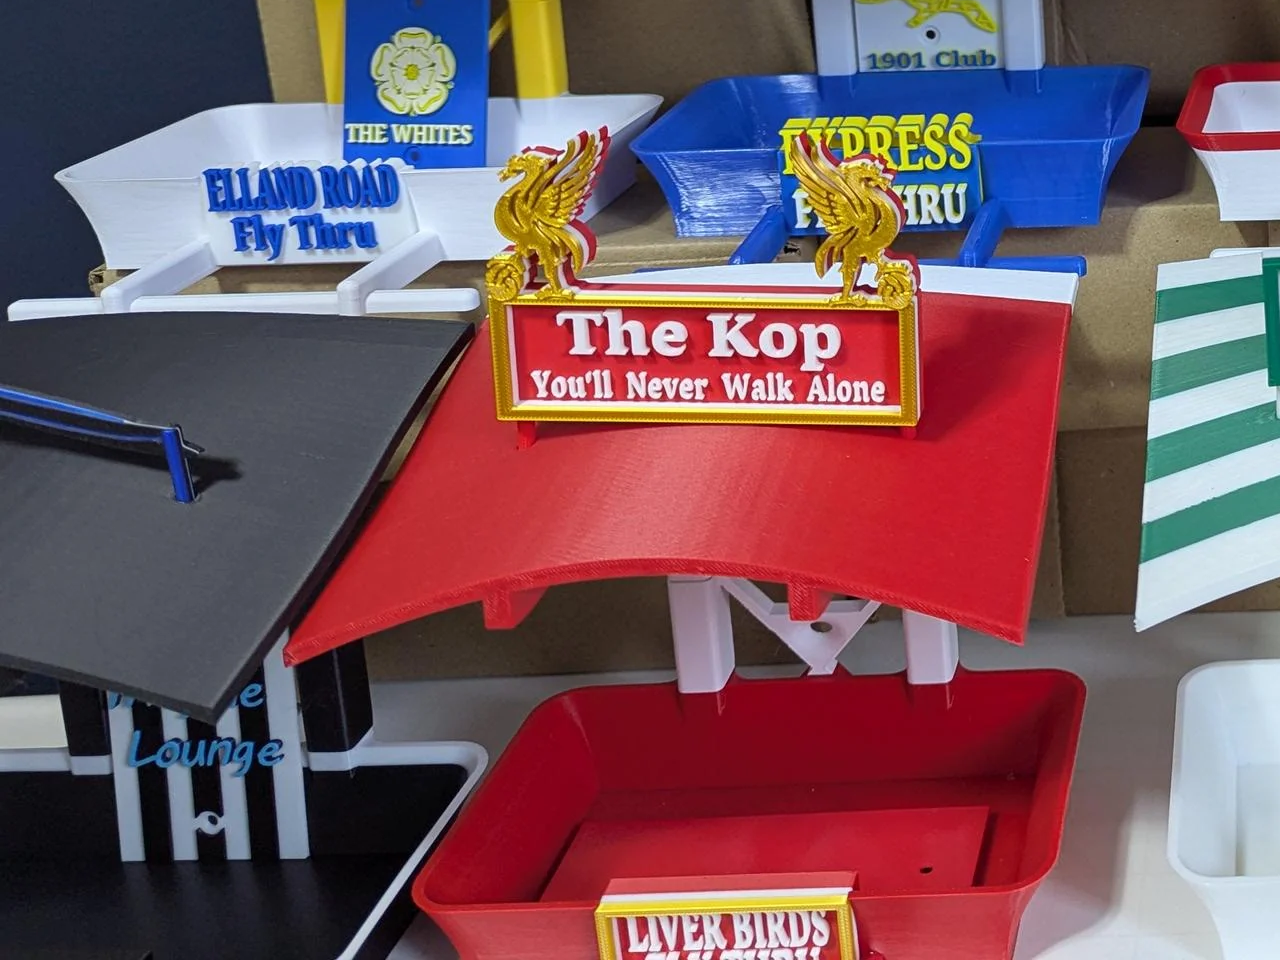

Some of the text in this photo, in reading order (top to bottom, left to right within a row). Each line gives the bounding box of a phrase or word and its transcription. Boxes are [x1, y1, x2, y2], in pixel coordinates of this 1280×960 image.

[867, 49, 997, 70] 1901 Club
[345, 123, 474, 145] THE WHITES
[203, 164, 400, 212] ELLAND ROAD
[231, 213, 378, 261] Fly Thru
[556, 309, 842, 372] The Kop
[531, 369, 886, 403] You'll Never Walk Alone
[128, 729, 285, 778] Lounge
[626, 910, 831, 953] LIVER BIRDS
